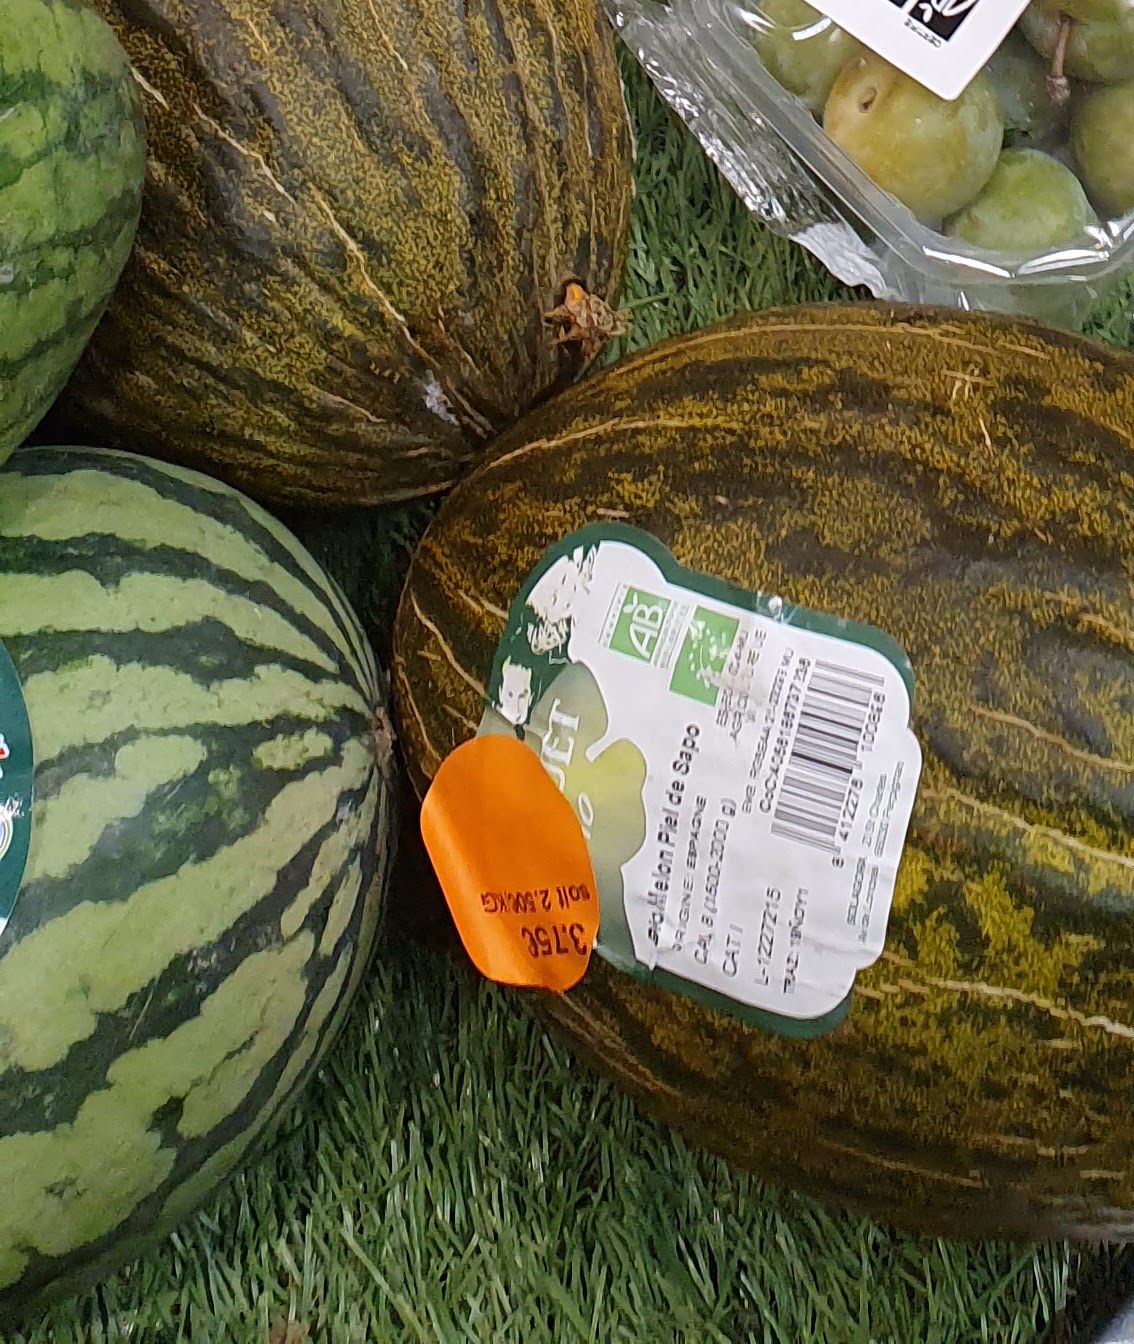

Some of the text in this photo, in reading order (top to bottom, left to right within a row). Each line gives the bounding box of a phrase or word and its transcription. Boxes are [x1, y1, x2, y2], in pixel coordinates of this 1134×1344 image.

[626, 604, 665, 659] AB
[674, 722, 702, 775] Sapo
[665, 778, 686, 806] de
[834, 777, 862, 841] 412278
[659, 808, 681, 847] Piel
[721, 933, 743, 976] CAT
